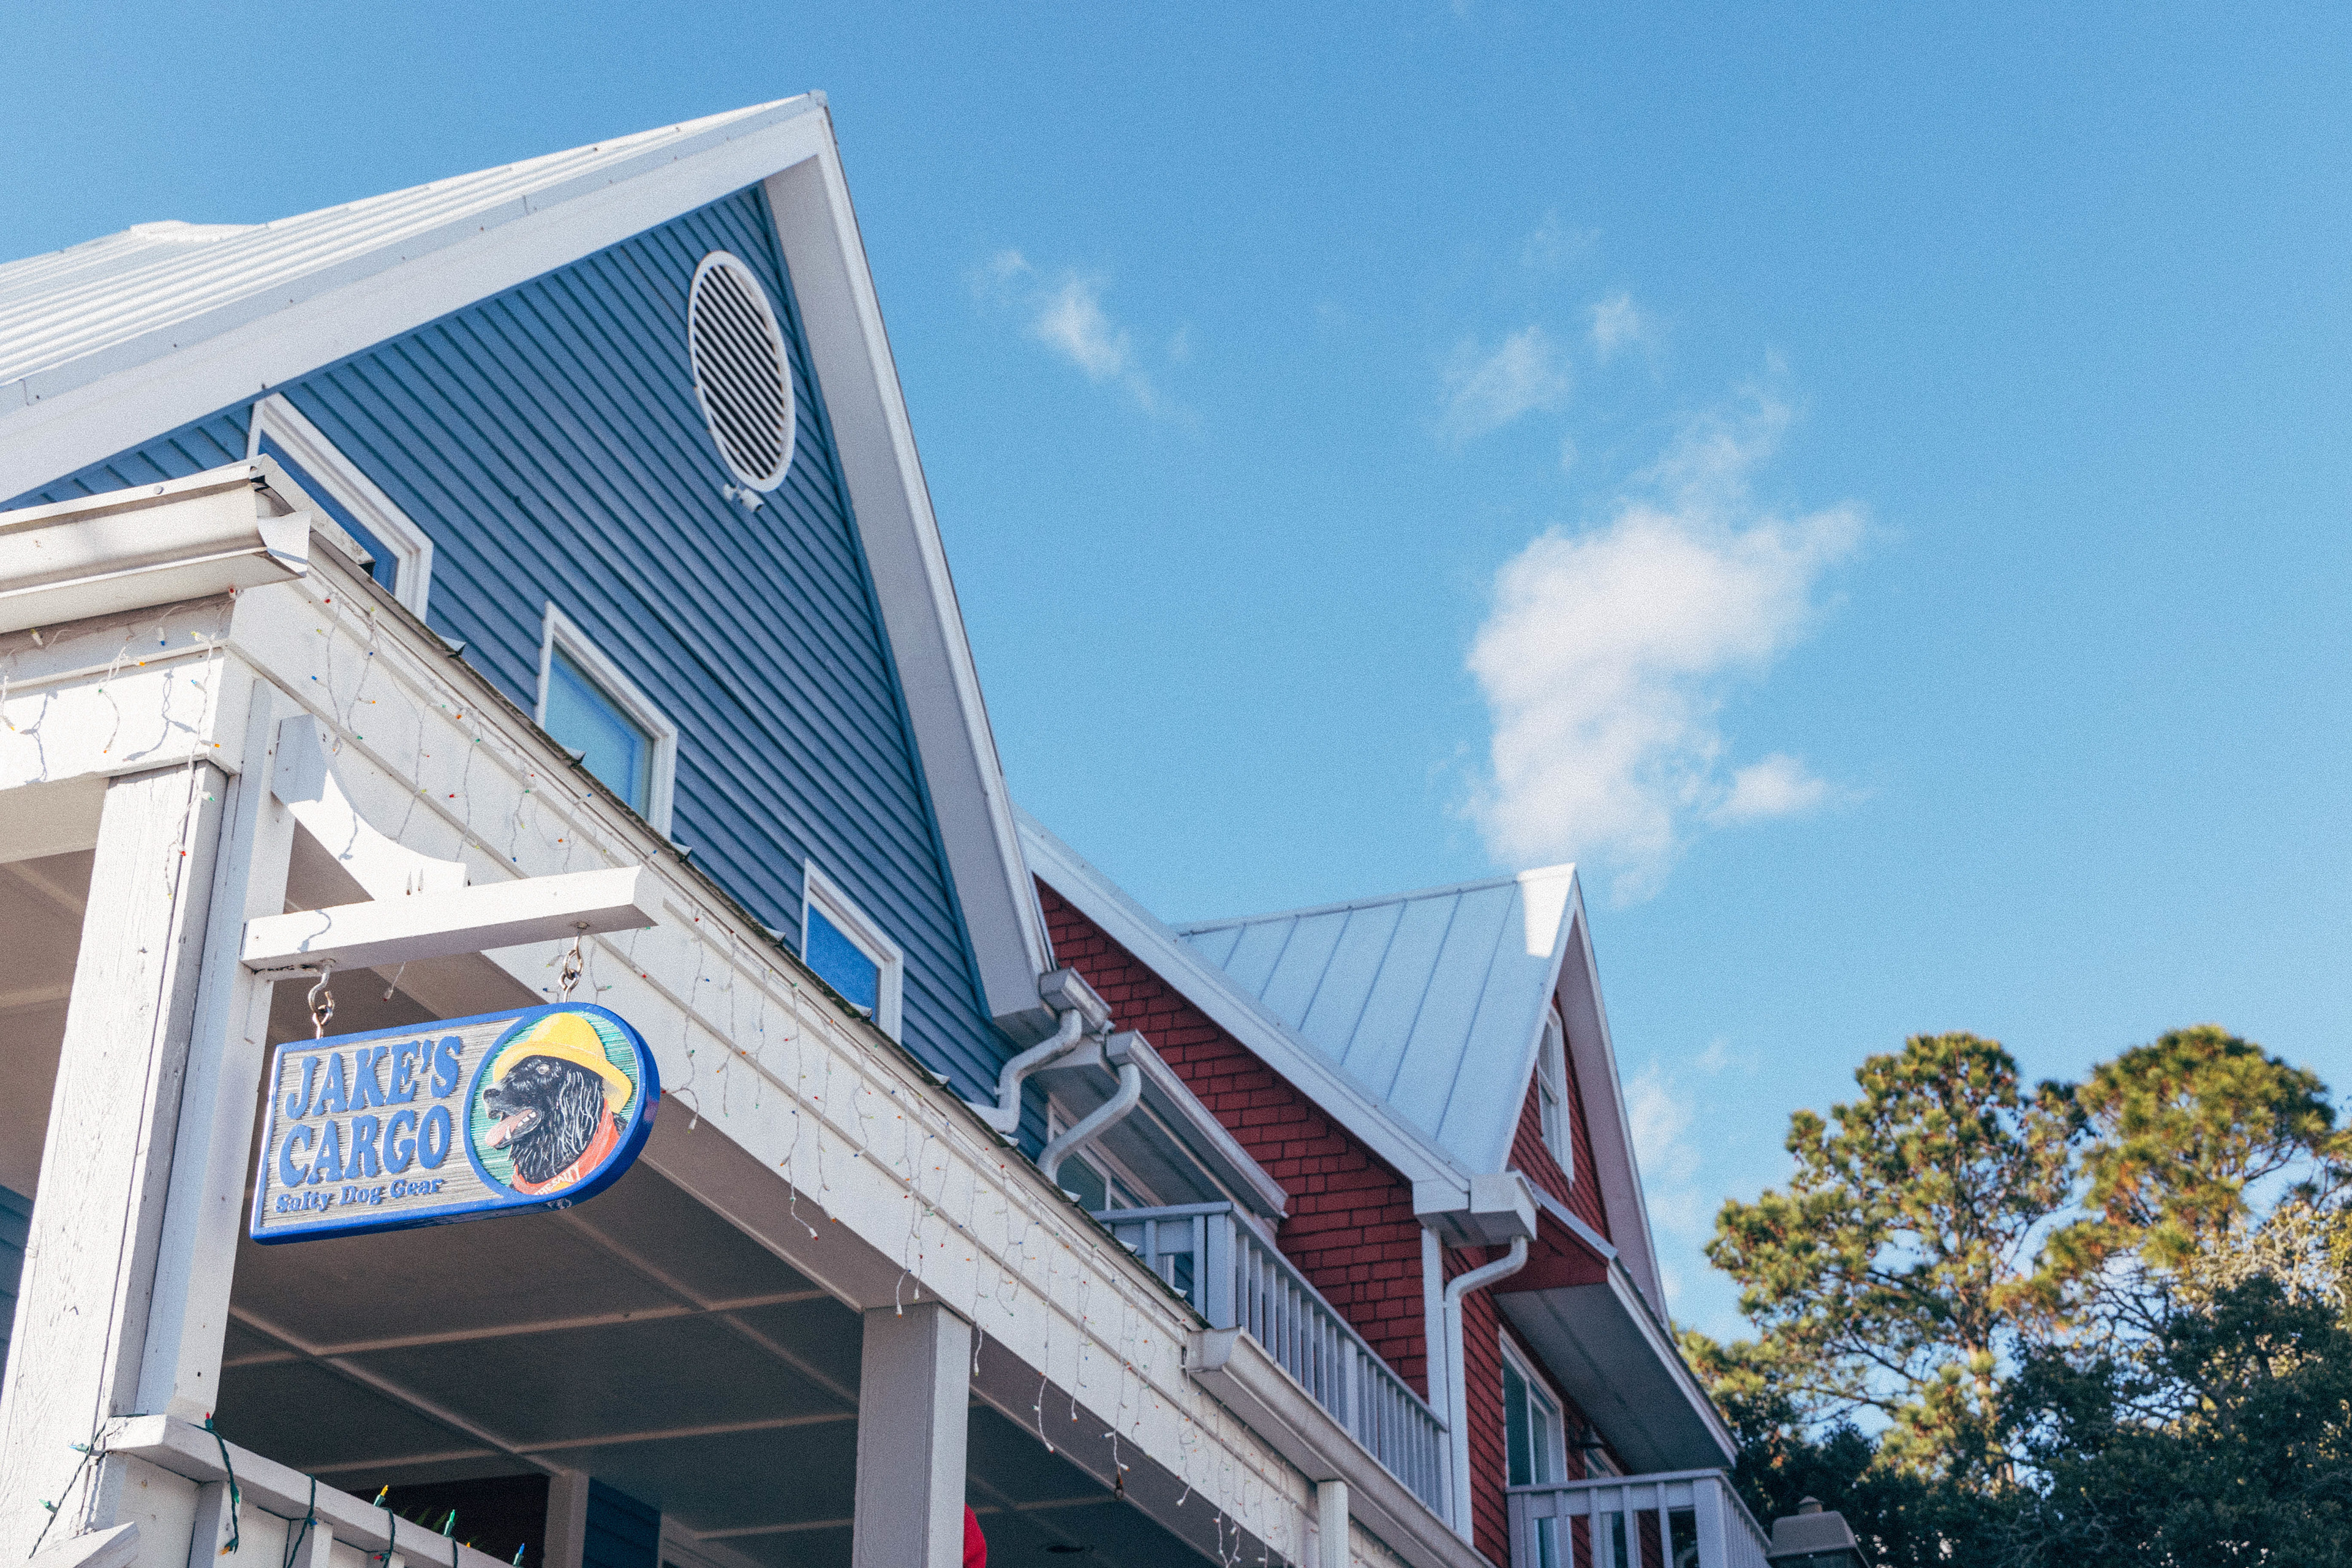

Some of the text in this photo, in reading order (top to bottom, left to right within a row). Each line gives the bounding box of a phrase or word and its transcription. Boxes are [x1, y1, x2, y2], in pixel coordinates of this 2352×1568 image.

[284, 1036, 461, 1119] JAKE'S
[279, 1105, 451, 1186] CARGO
[275, 1178, 443, 1213] Salty Dog Gear
